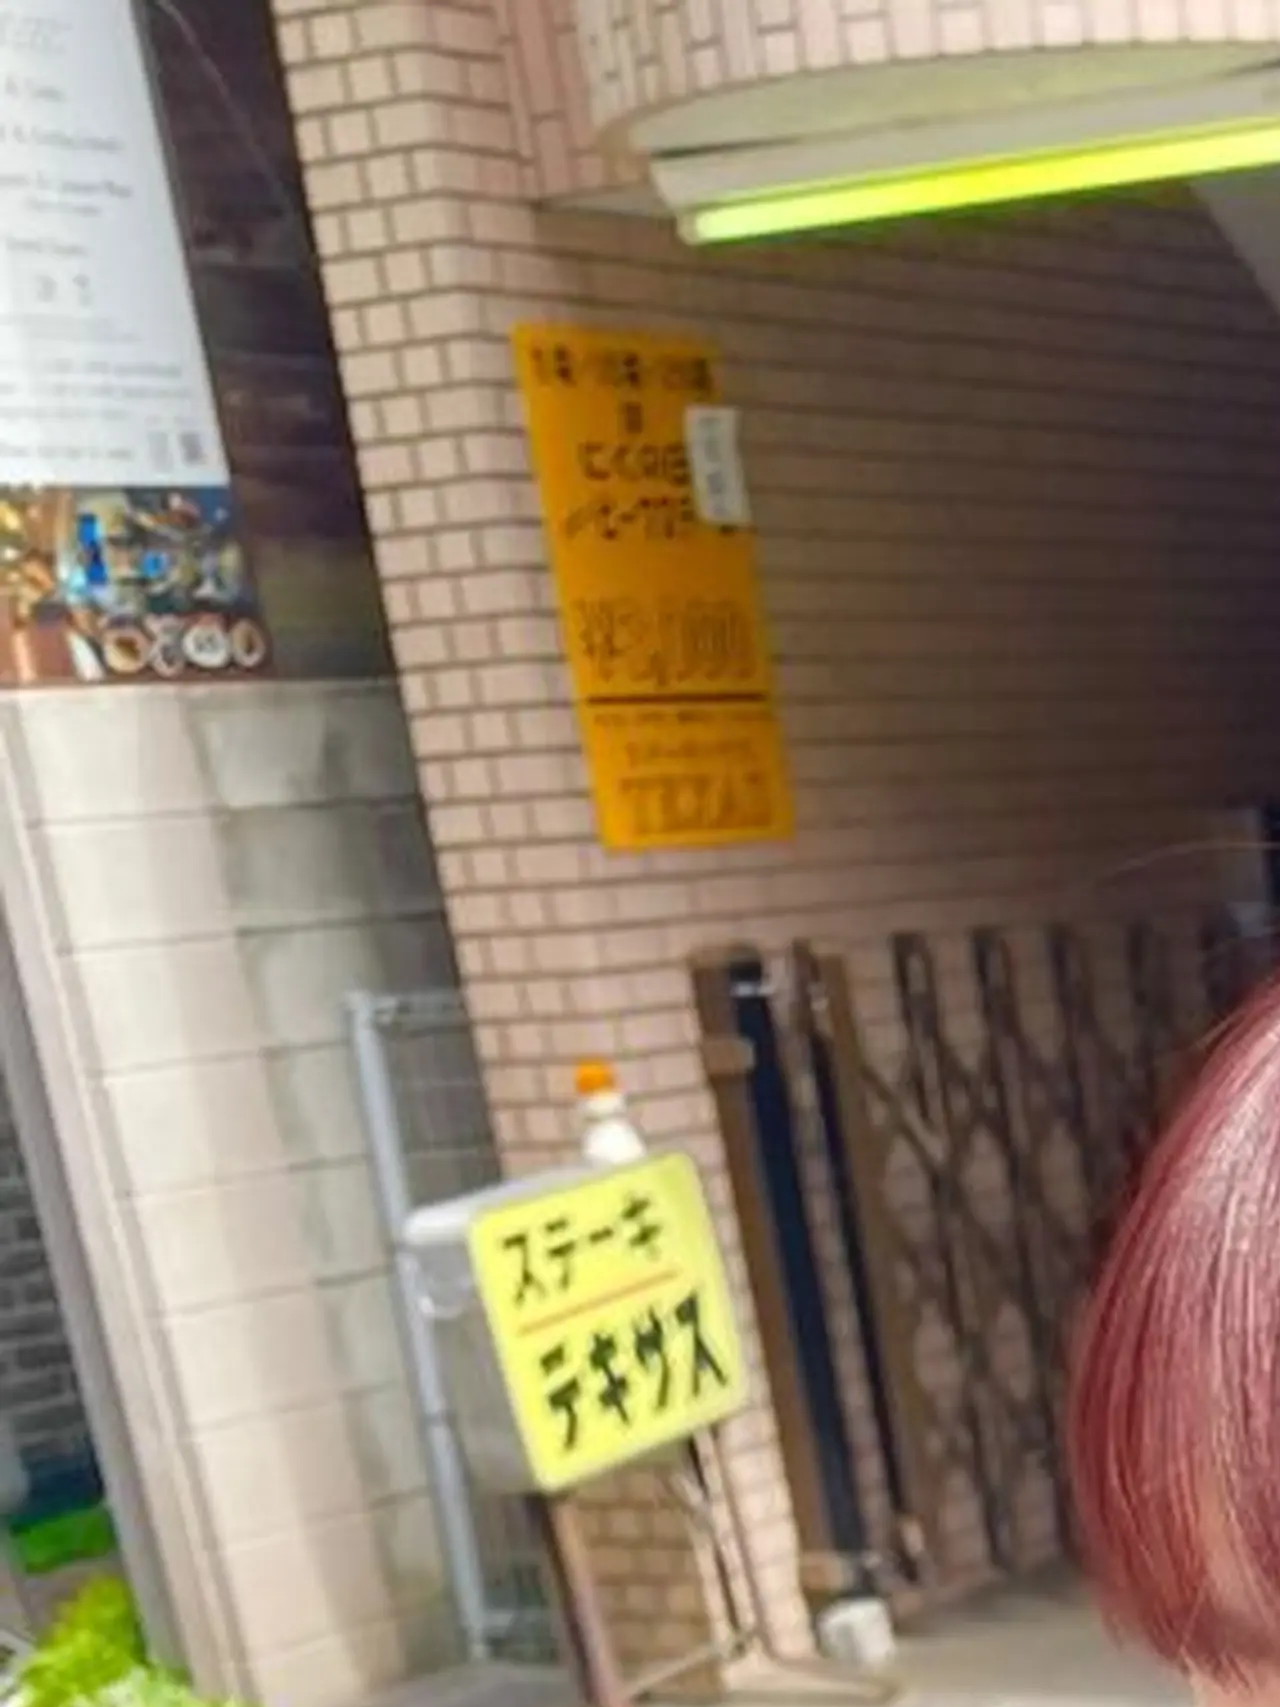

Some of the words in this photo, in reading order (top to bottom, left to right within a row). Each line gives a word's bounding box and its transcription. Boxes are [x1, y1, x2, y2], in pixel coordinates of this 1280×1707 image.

[501, 1196, 663, 1306] ステーキ
[539, 1288, 729, 1452] テキサス
